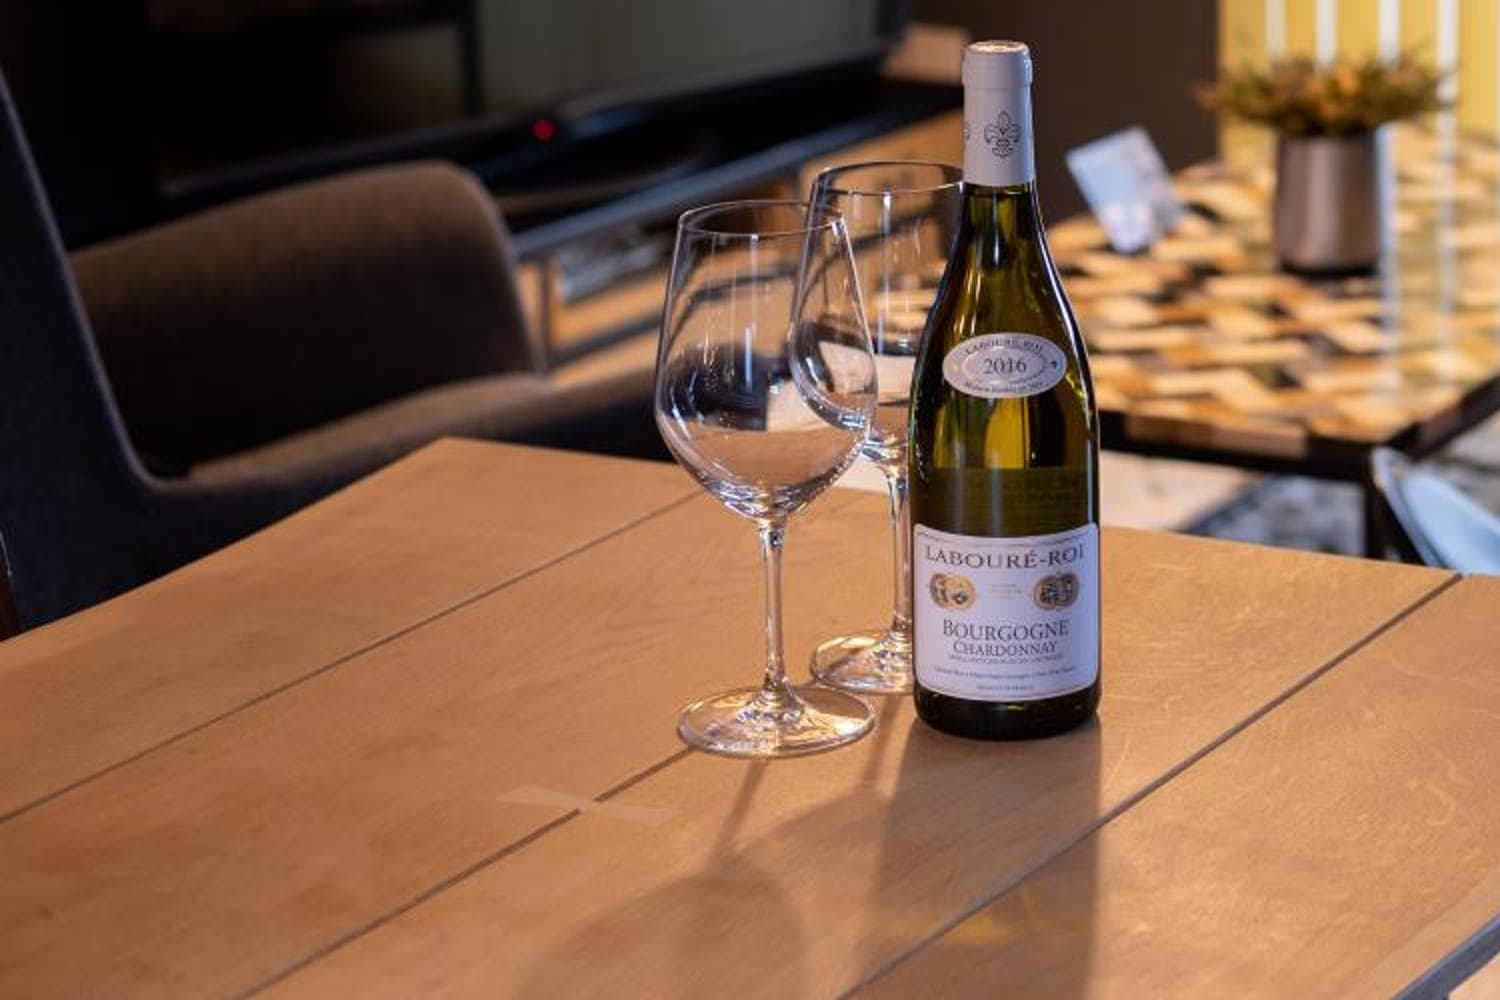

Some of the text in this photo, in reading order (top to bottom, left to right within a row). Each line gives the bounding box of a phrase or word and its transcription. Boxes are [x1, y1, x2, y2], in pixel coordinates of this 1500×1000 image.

[983, 358, 1027, 375] 2016
[926, 544, 1083, 569] LABOURÉ-ROI
[943, 618, 1069, 642] BOURGOGNE
[953, 640, 1057, 657] CHARDONNAY
